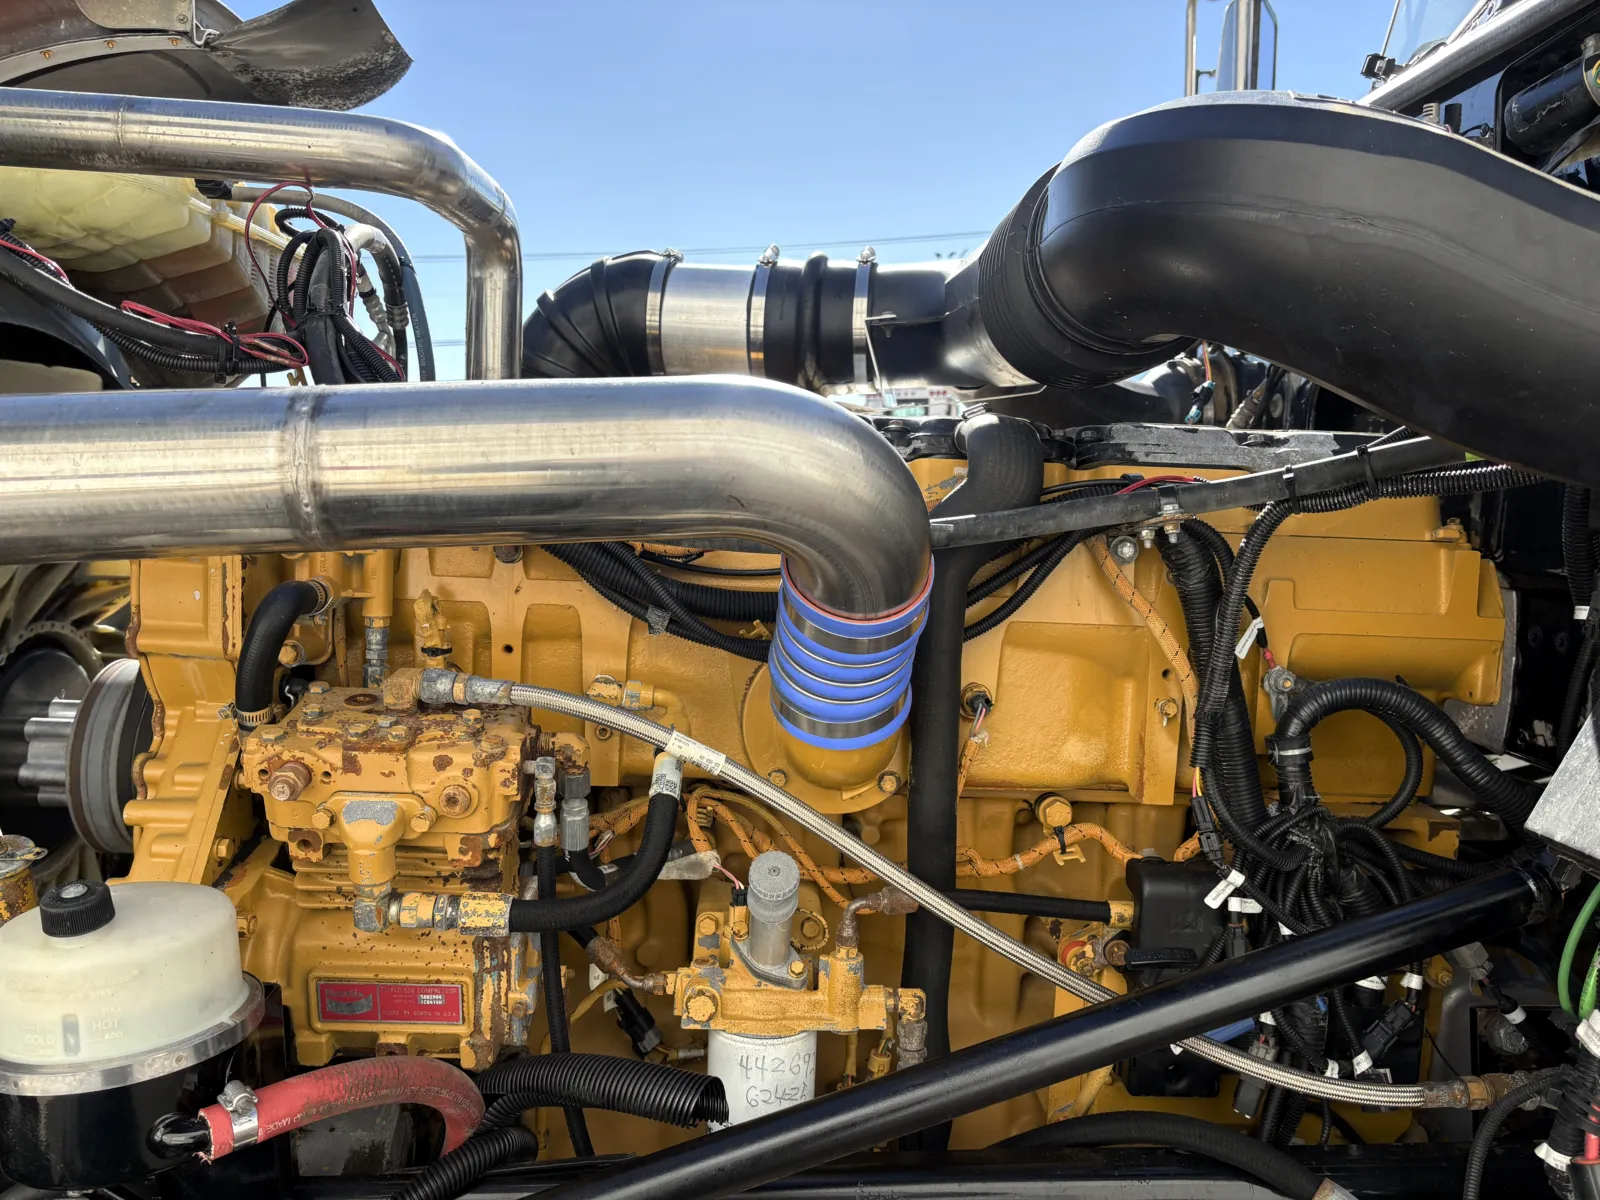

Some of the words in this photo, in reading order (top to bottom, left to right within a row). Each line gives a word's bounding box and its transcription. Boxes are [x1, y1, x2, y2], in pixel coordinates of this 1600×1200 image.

[412, 313, 421, 338] HEATER
[417, 987, 457, 995] COMPRESSOR
[92, 1018, 119, 1031] HOT
[24, 1033, 55, 1046] COLD
[104, 1031, 124, 1041] ADD
